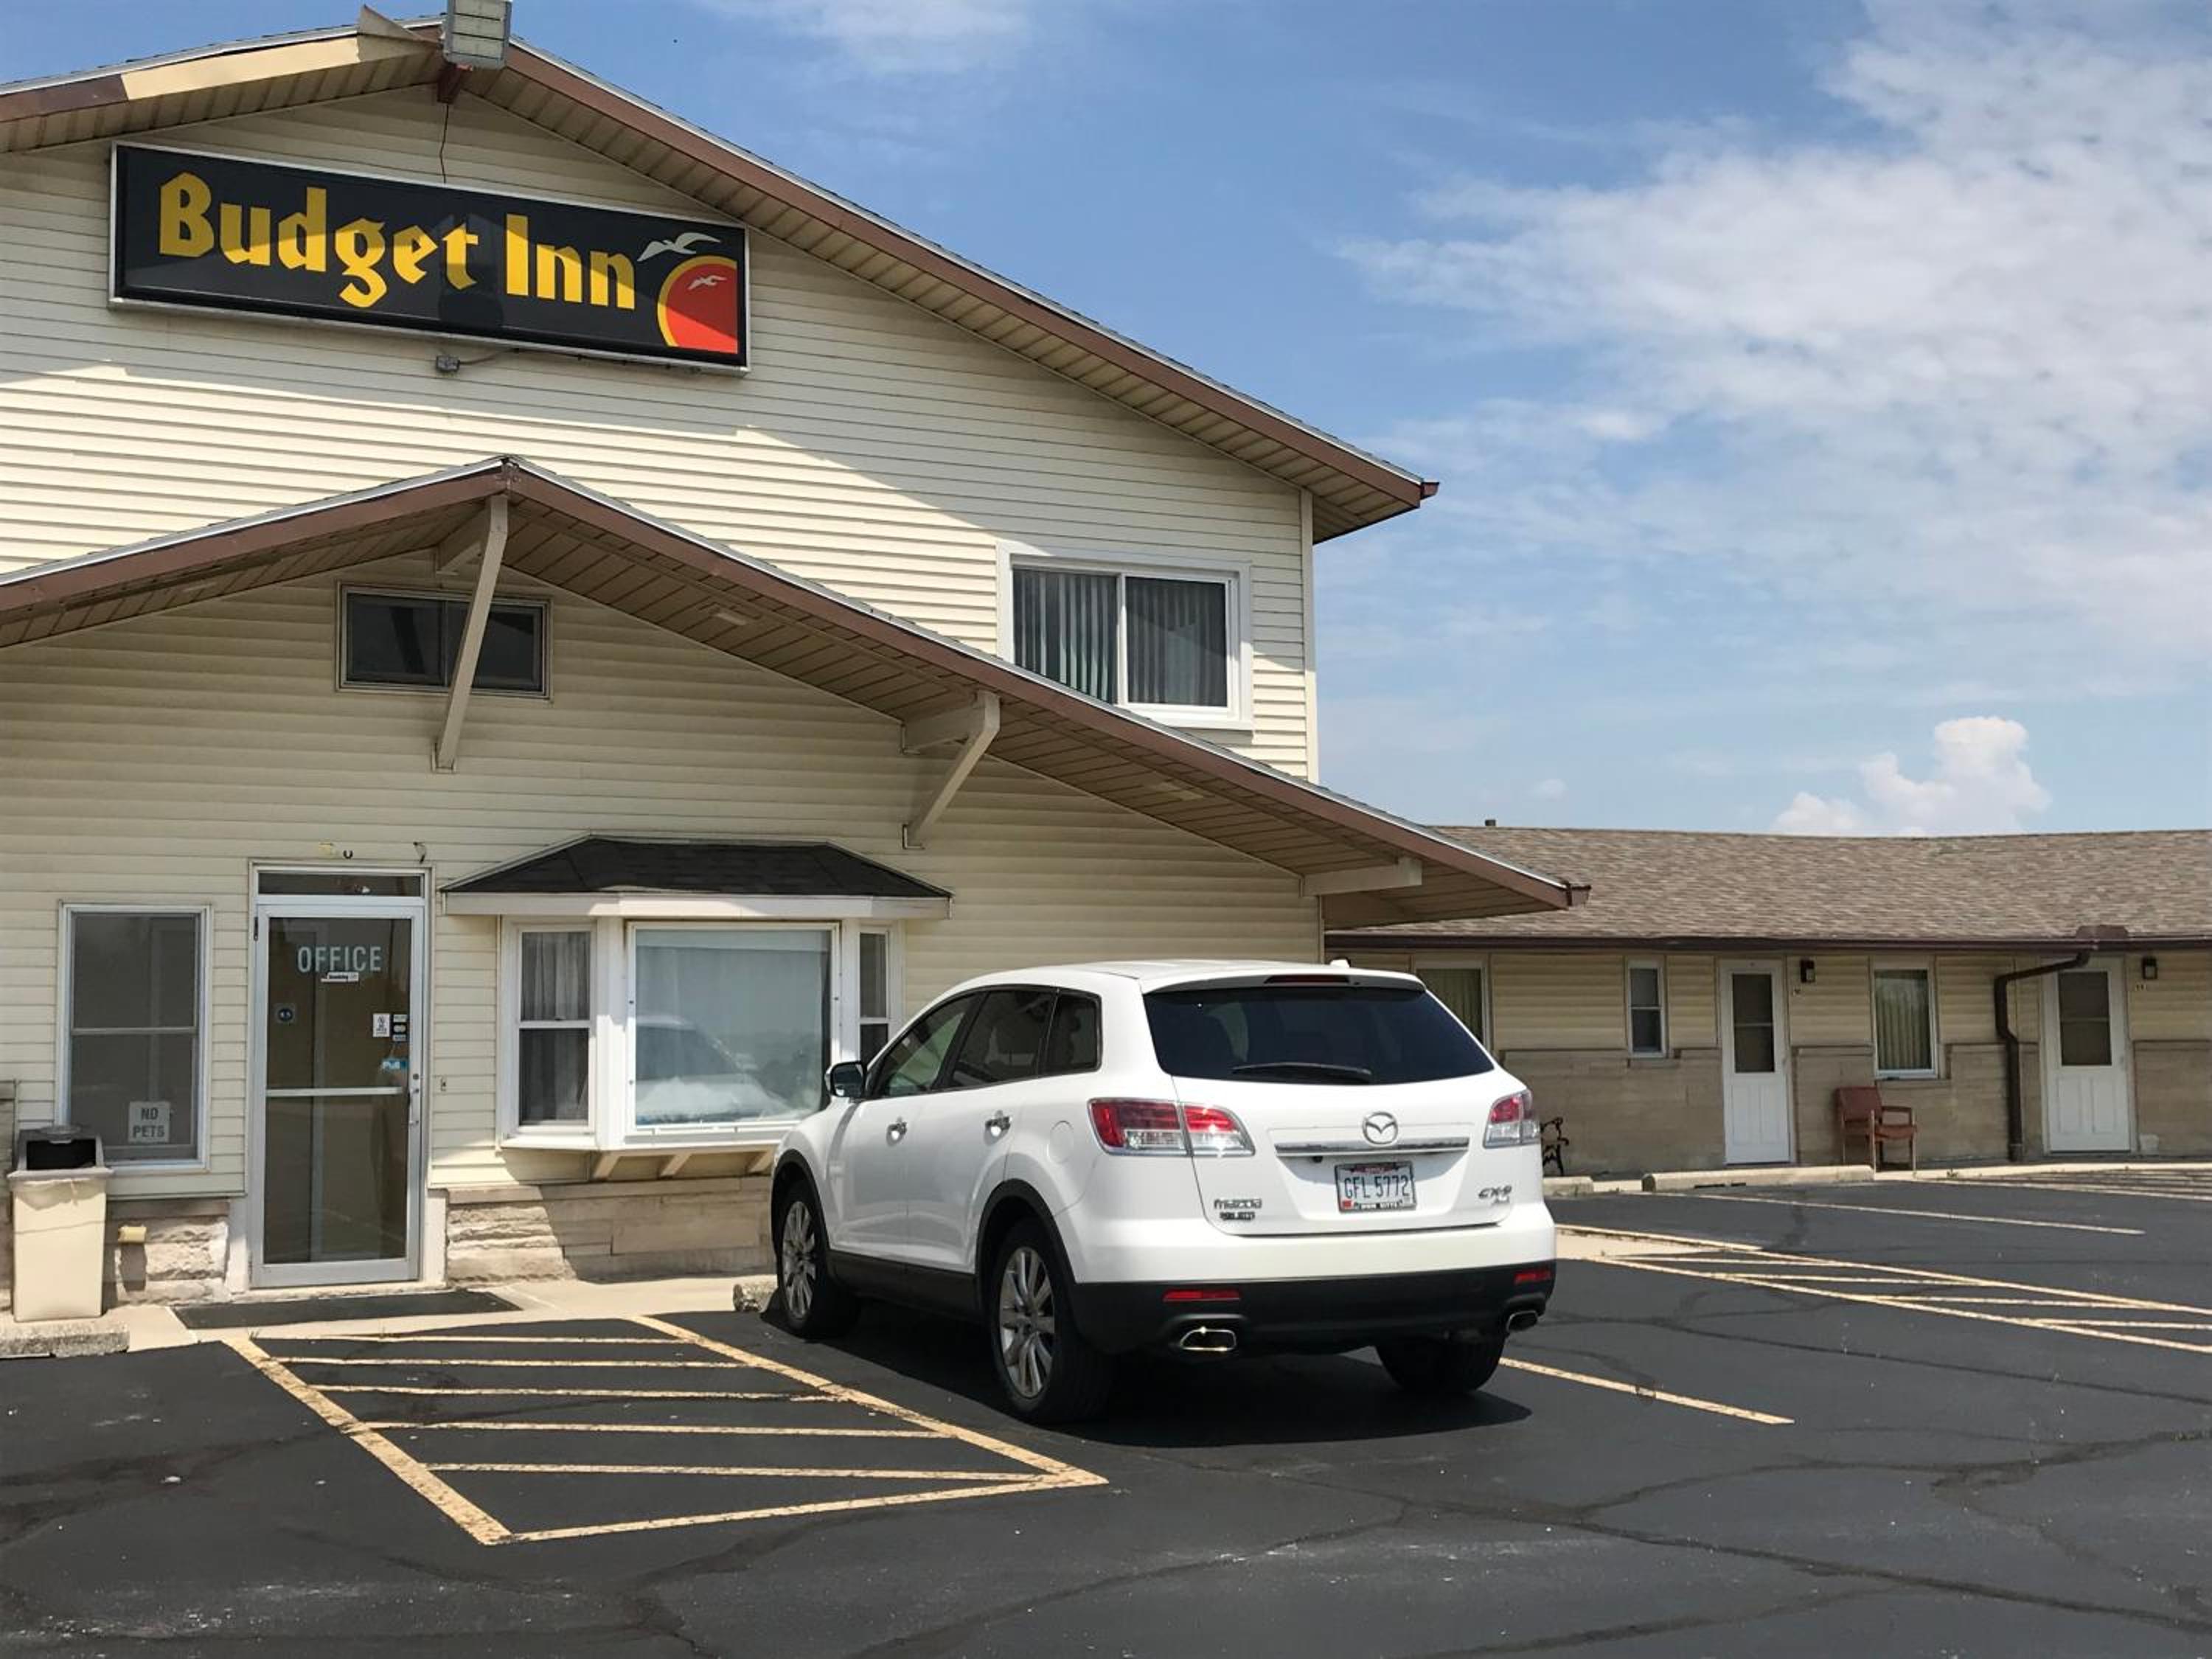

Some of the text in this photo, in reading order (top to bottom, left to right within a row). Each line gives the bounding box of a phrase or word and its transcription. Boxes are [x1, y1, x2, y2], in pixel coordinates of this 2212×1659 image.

[159, 171, 635, 310] Budget Inn
[297, 946, 381, 973] OFFICE
[141, 1107, 159, 1120] NO
[133, 1125, 165, 1138] PETS
[1344, 1175, 1409, 1198] GFL 5772
